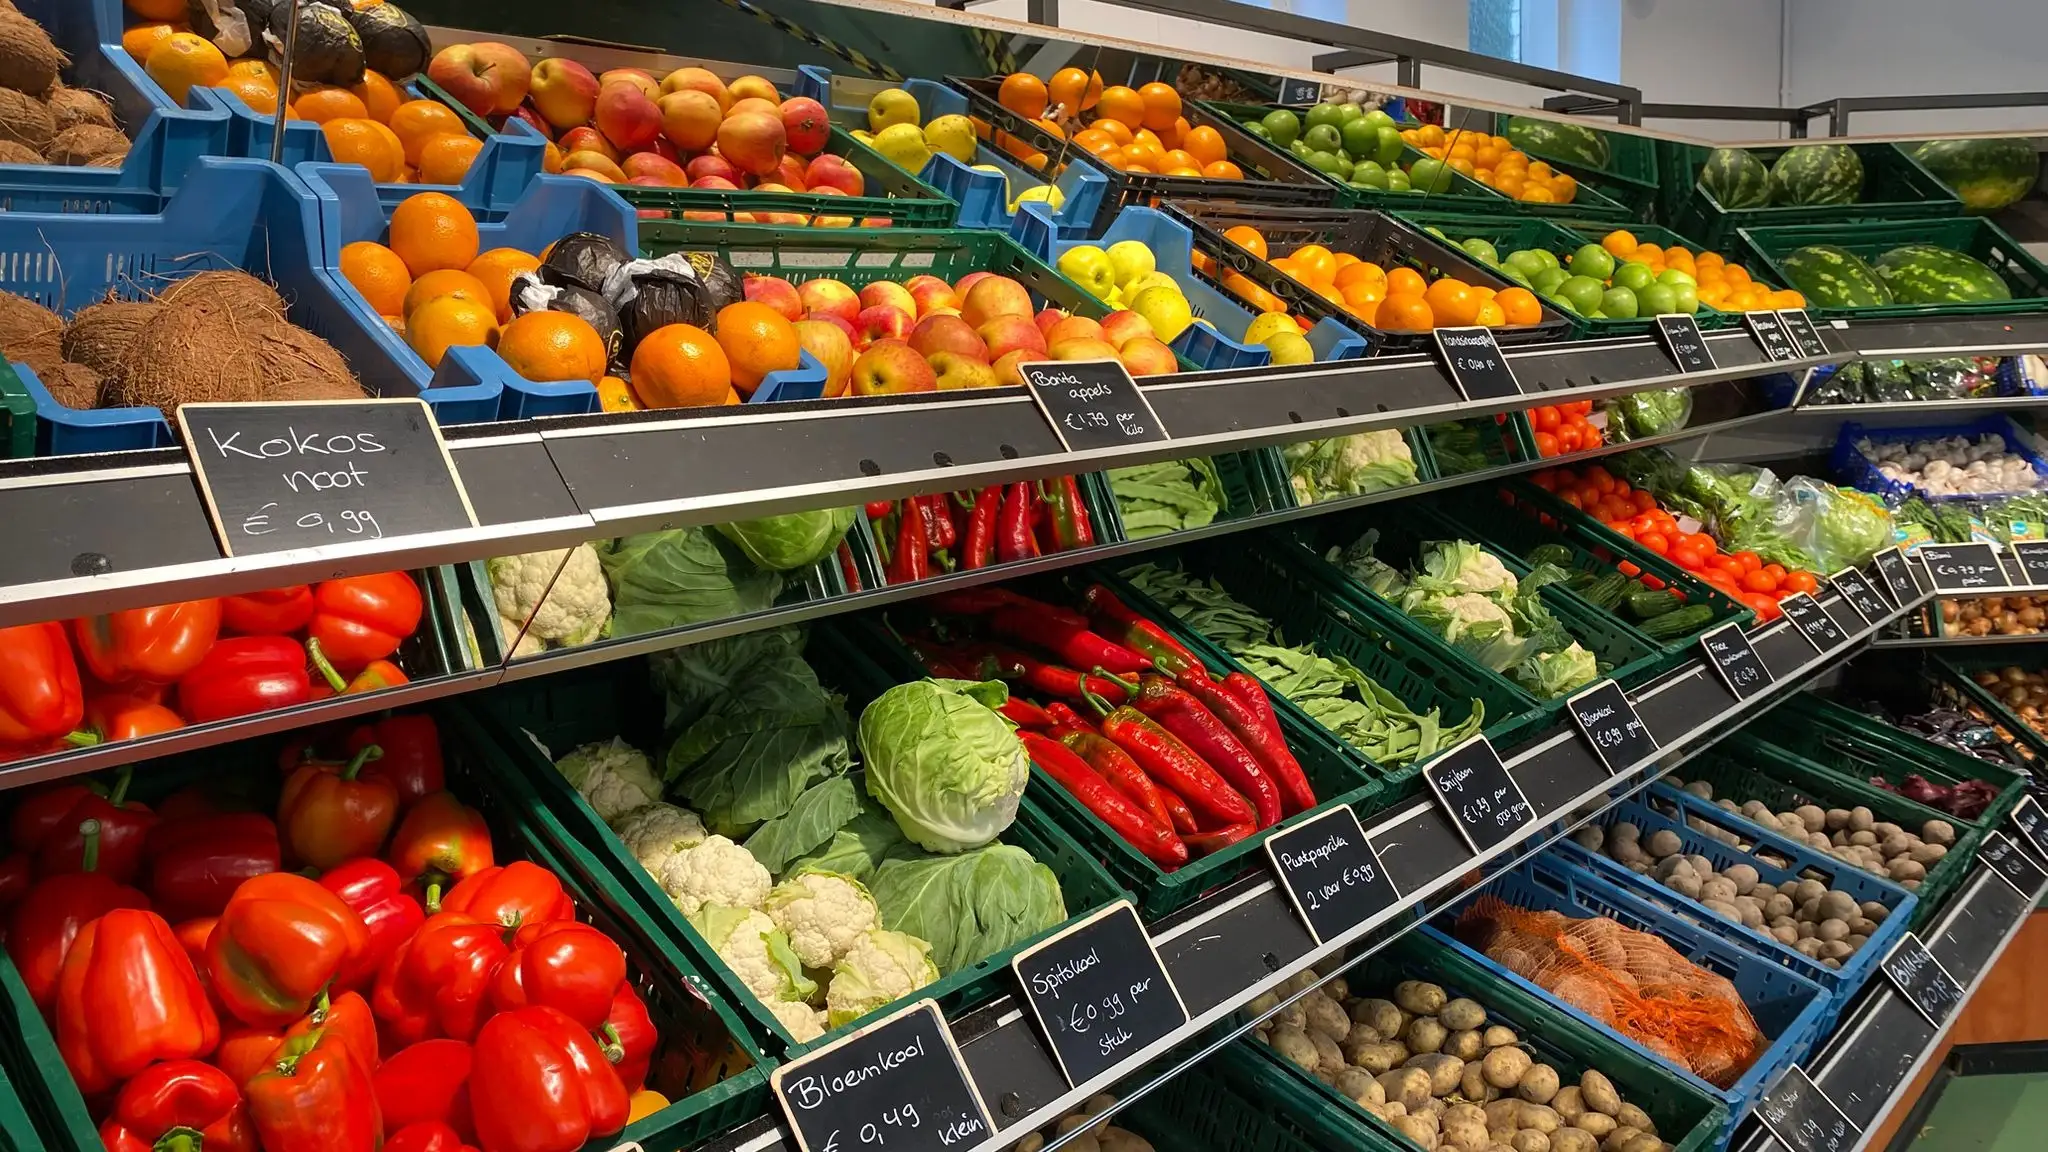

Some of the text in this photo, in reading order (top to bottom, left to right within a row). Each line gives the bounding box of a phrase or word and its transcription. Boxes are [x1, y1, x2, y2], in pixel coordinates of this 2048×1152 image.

[1030, 370, 1082, 387] Bonita
[1069, 382, 1112, 403] appels
[1115, 411, 1135, 428] per
[1122, 424, 1144, 436] kilo
[207, 426, 387, 459] Kokos
[282, 461, 369, 492] noot
[1493, 786, 1507, 805] per
[1495, 808, 1511, 827] 500
[1280, 835, 1349, 871] Puntpaprika
[1306, 890, 1321, 911] 2
[1319, 880, 1341, 901] voor
[1032, 946, 1101, 1000] Spitskool
[1129, 977, 1152, 1004] per
[787, 1034, 925, 1110] Bloemkool
